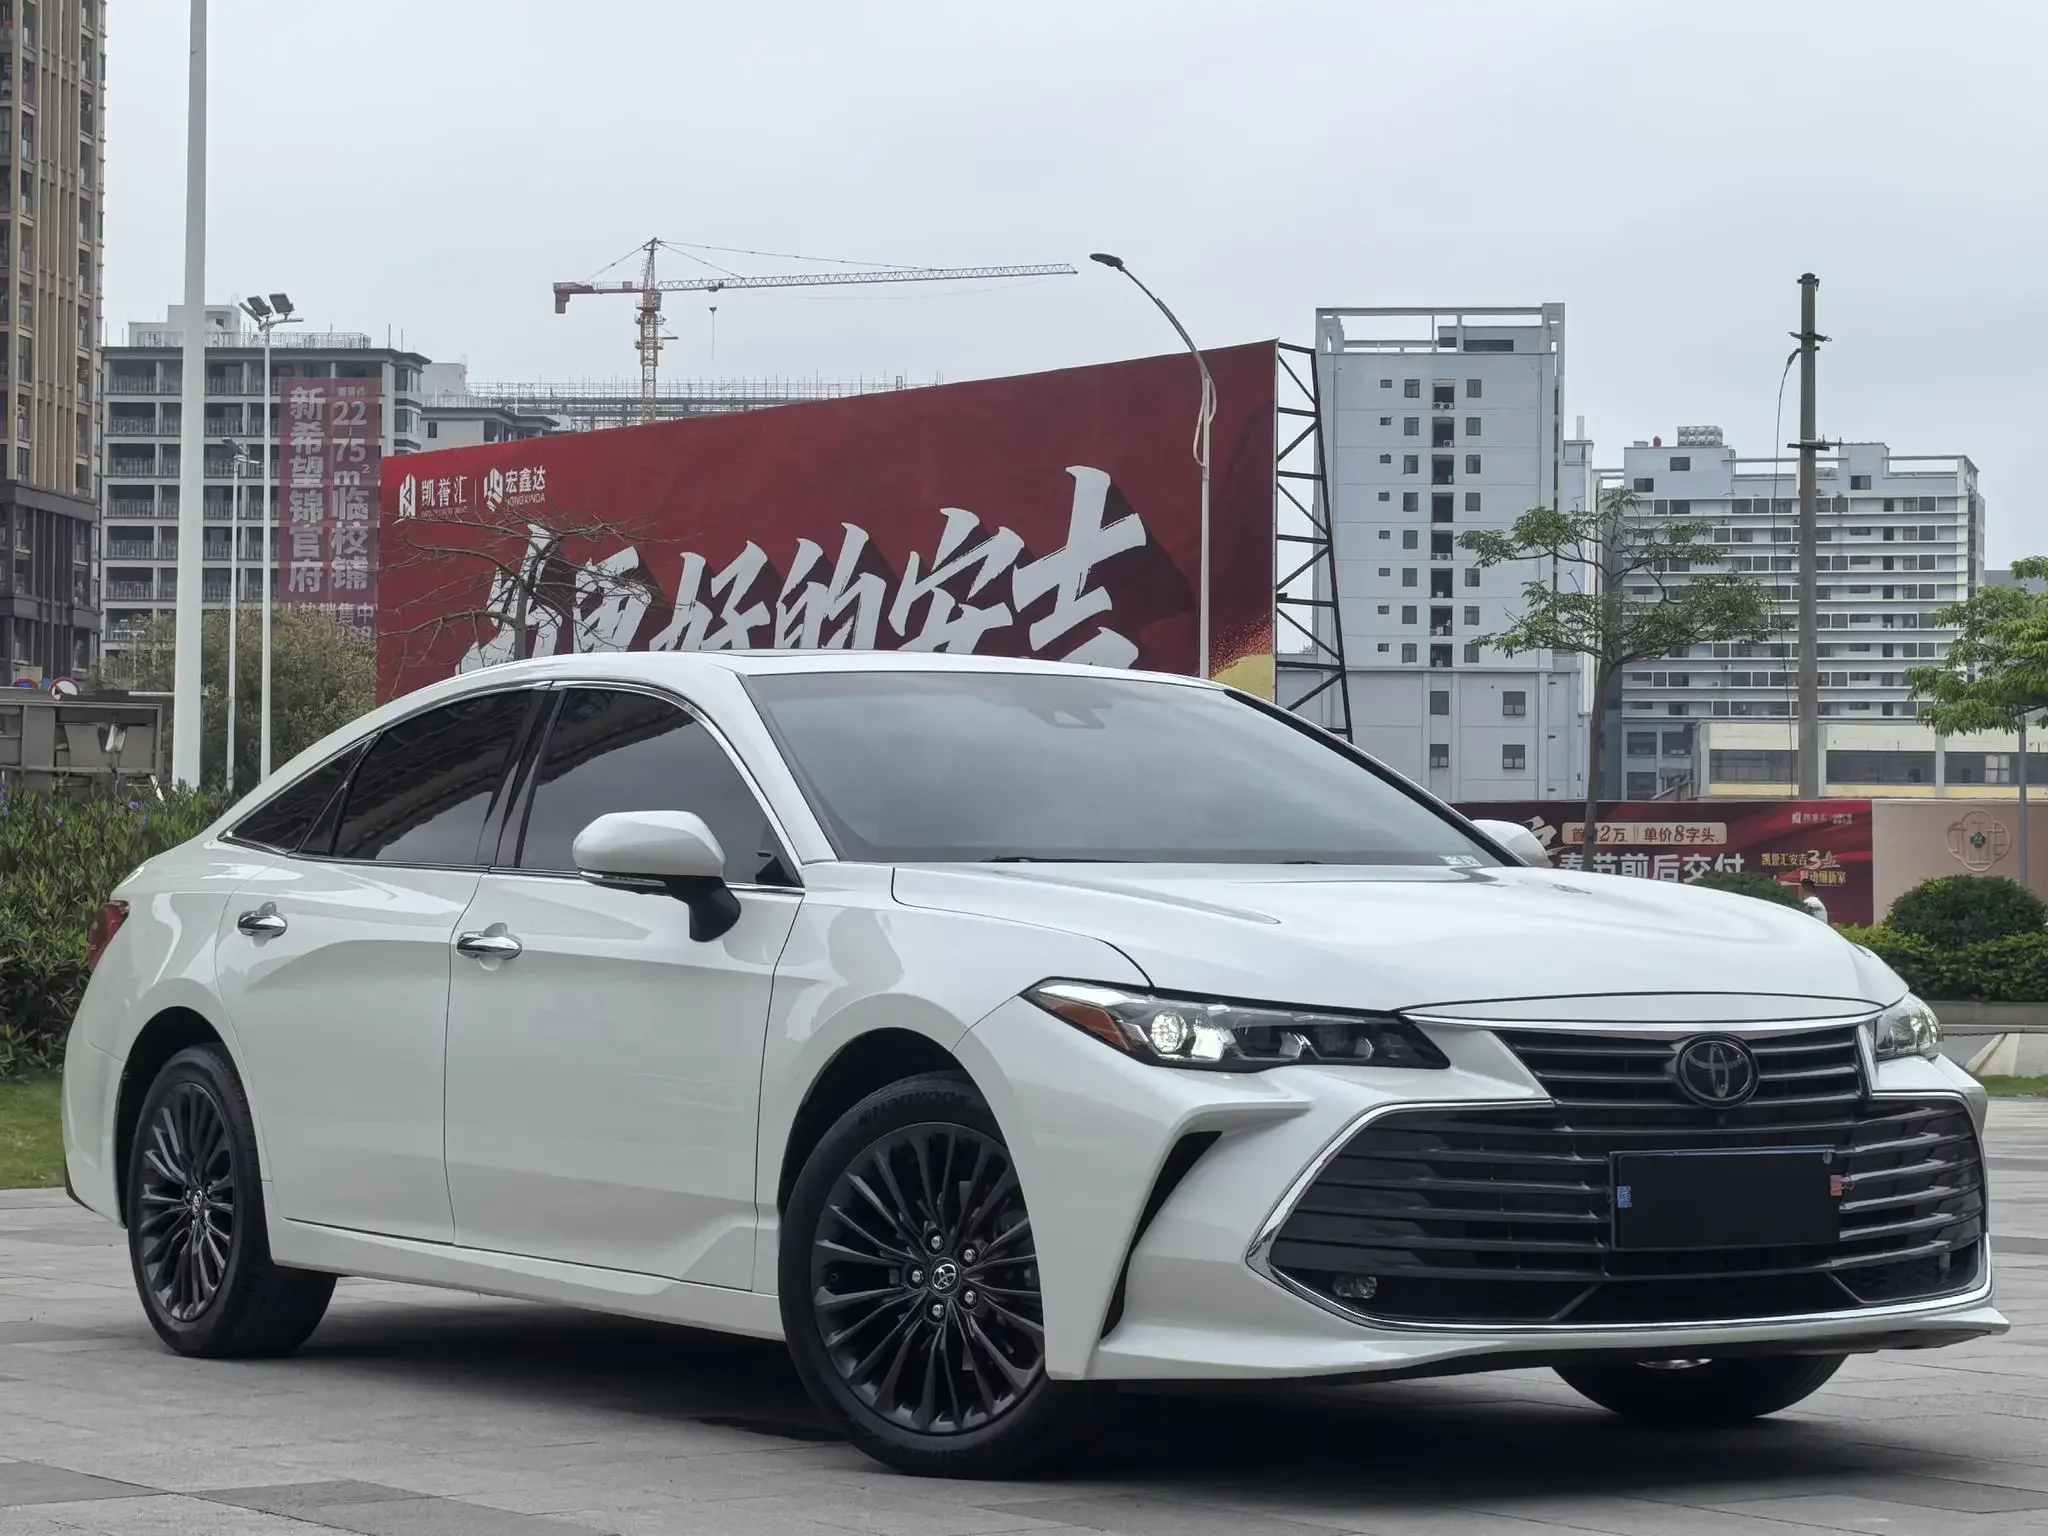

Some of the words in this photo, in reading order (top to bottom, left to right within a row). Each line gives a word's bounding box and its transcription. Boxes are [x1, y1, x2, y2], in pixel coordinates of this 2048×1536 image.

[289, 386, 326, 593] 新希望锦官府
[421, 476, 468, 508] 凯誉汇
[505, 465, 547, 494] 宏鑫达
[1571, 825, 1627, 843] 首2万
[1644, 825, 1716, 844] 单价8字头
